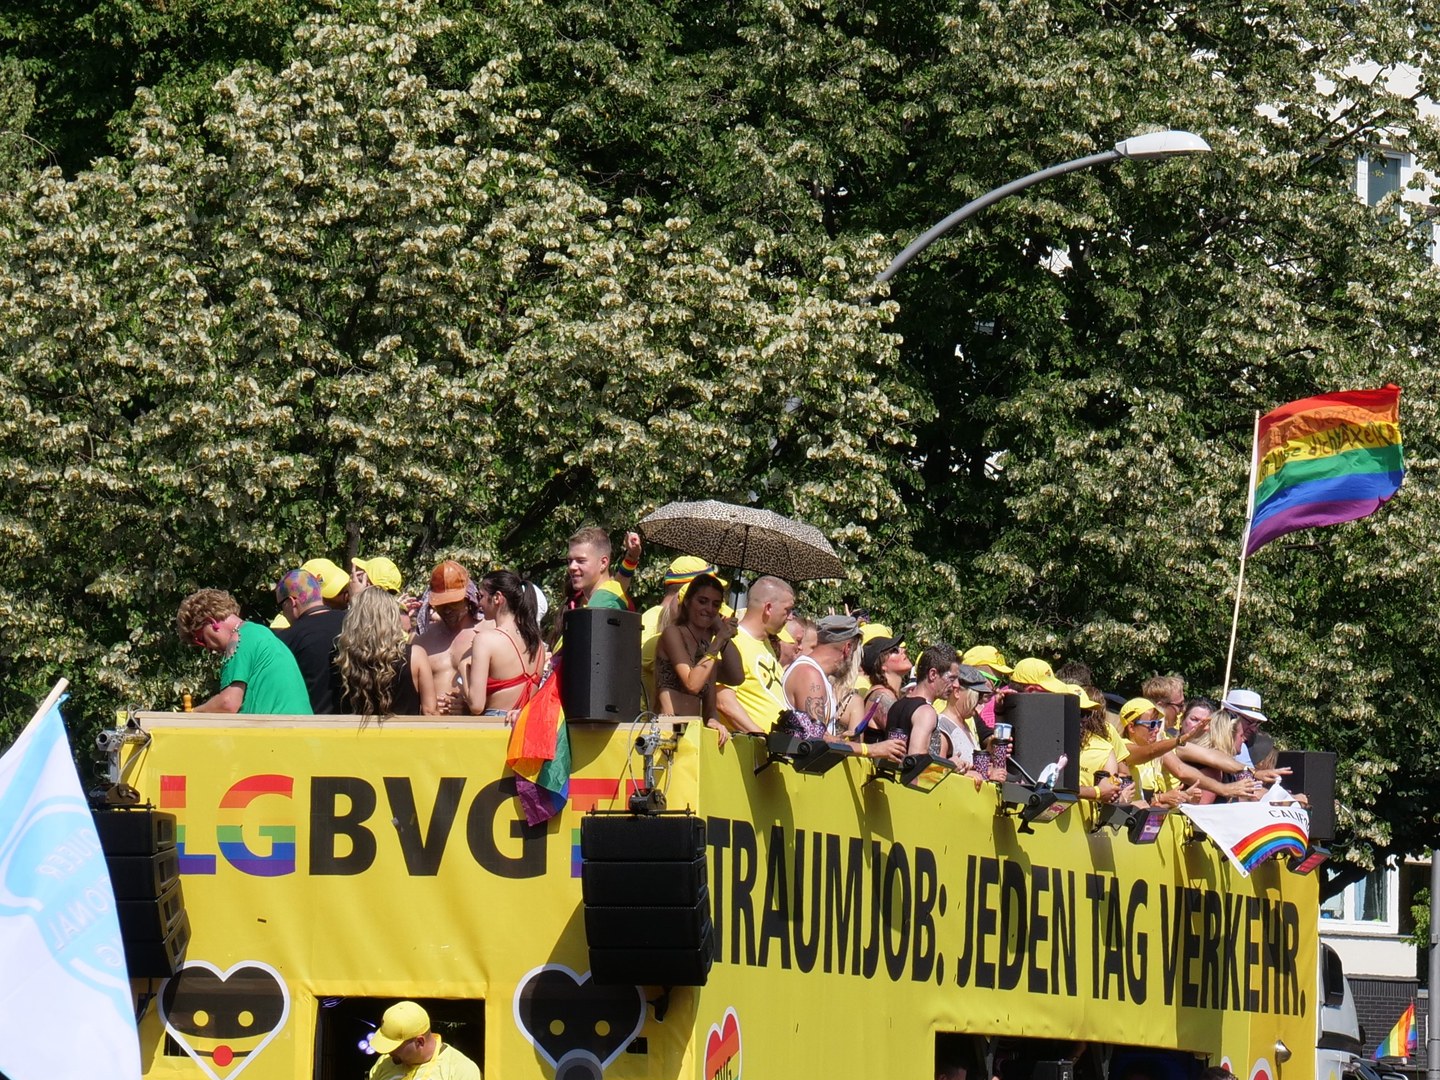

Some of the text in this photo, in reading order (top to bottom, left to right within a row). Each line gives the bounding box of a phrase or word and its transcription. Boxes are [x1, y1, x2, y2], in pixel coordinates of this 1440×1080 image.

[706, 815, 1306, 1018] TRAUMJOB: JEDEN TAG VERKEHR.
